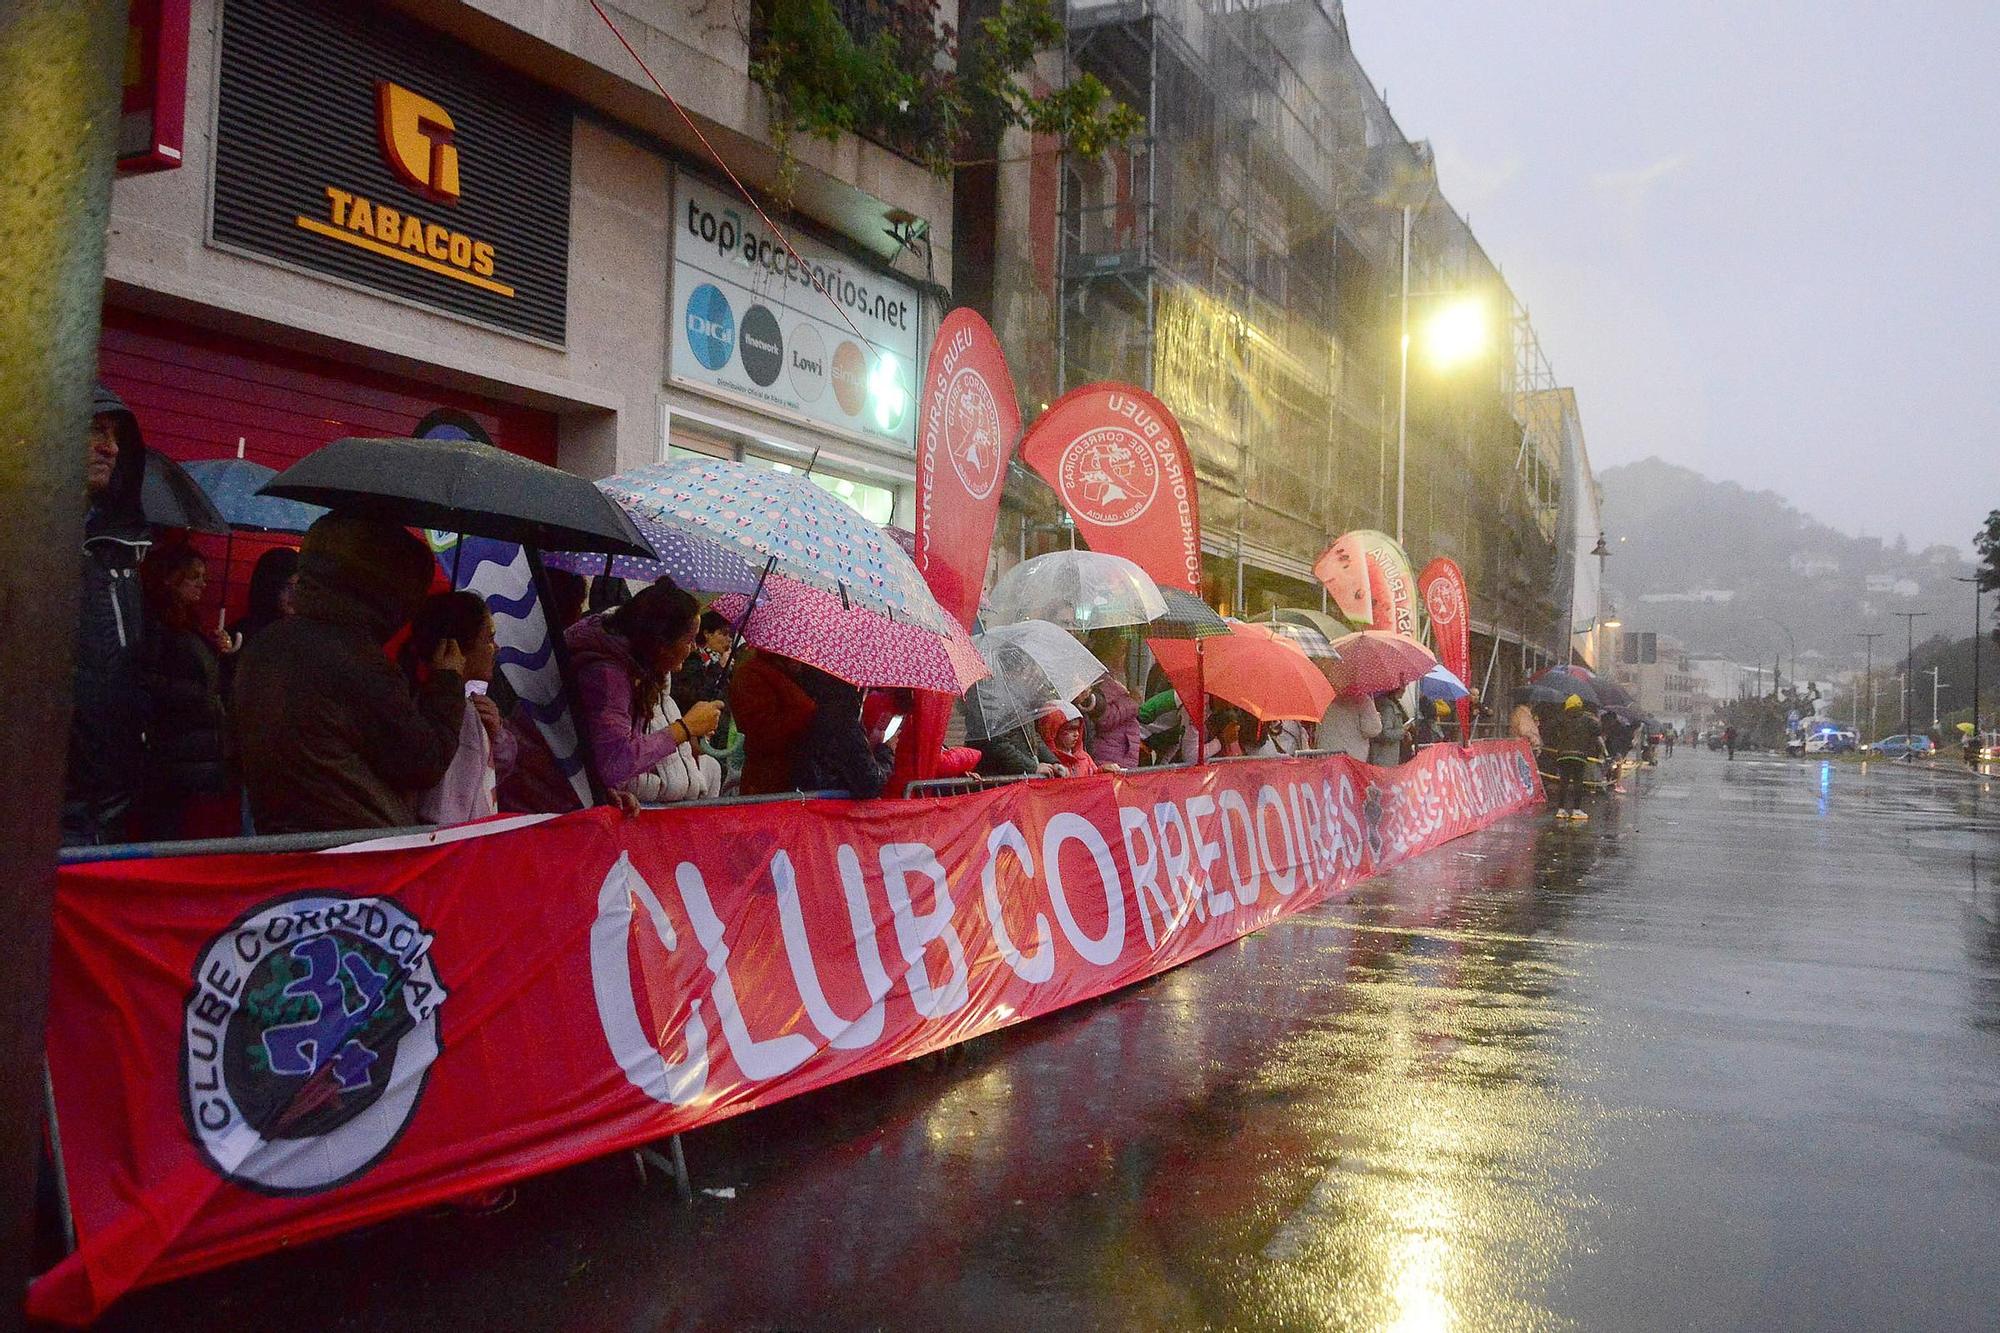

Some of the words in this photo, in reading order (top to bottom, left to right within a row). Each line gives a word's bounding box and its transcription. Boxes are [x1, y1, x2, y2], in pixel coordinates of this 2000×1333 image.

[326, 185, 495, 277] TABACOS
[793, 350, 823, 376] Lowi
[943, 326, 973, 374] BUEU
[192, 960, 242, 1132] CLUBE
